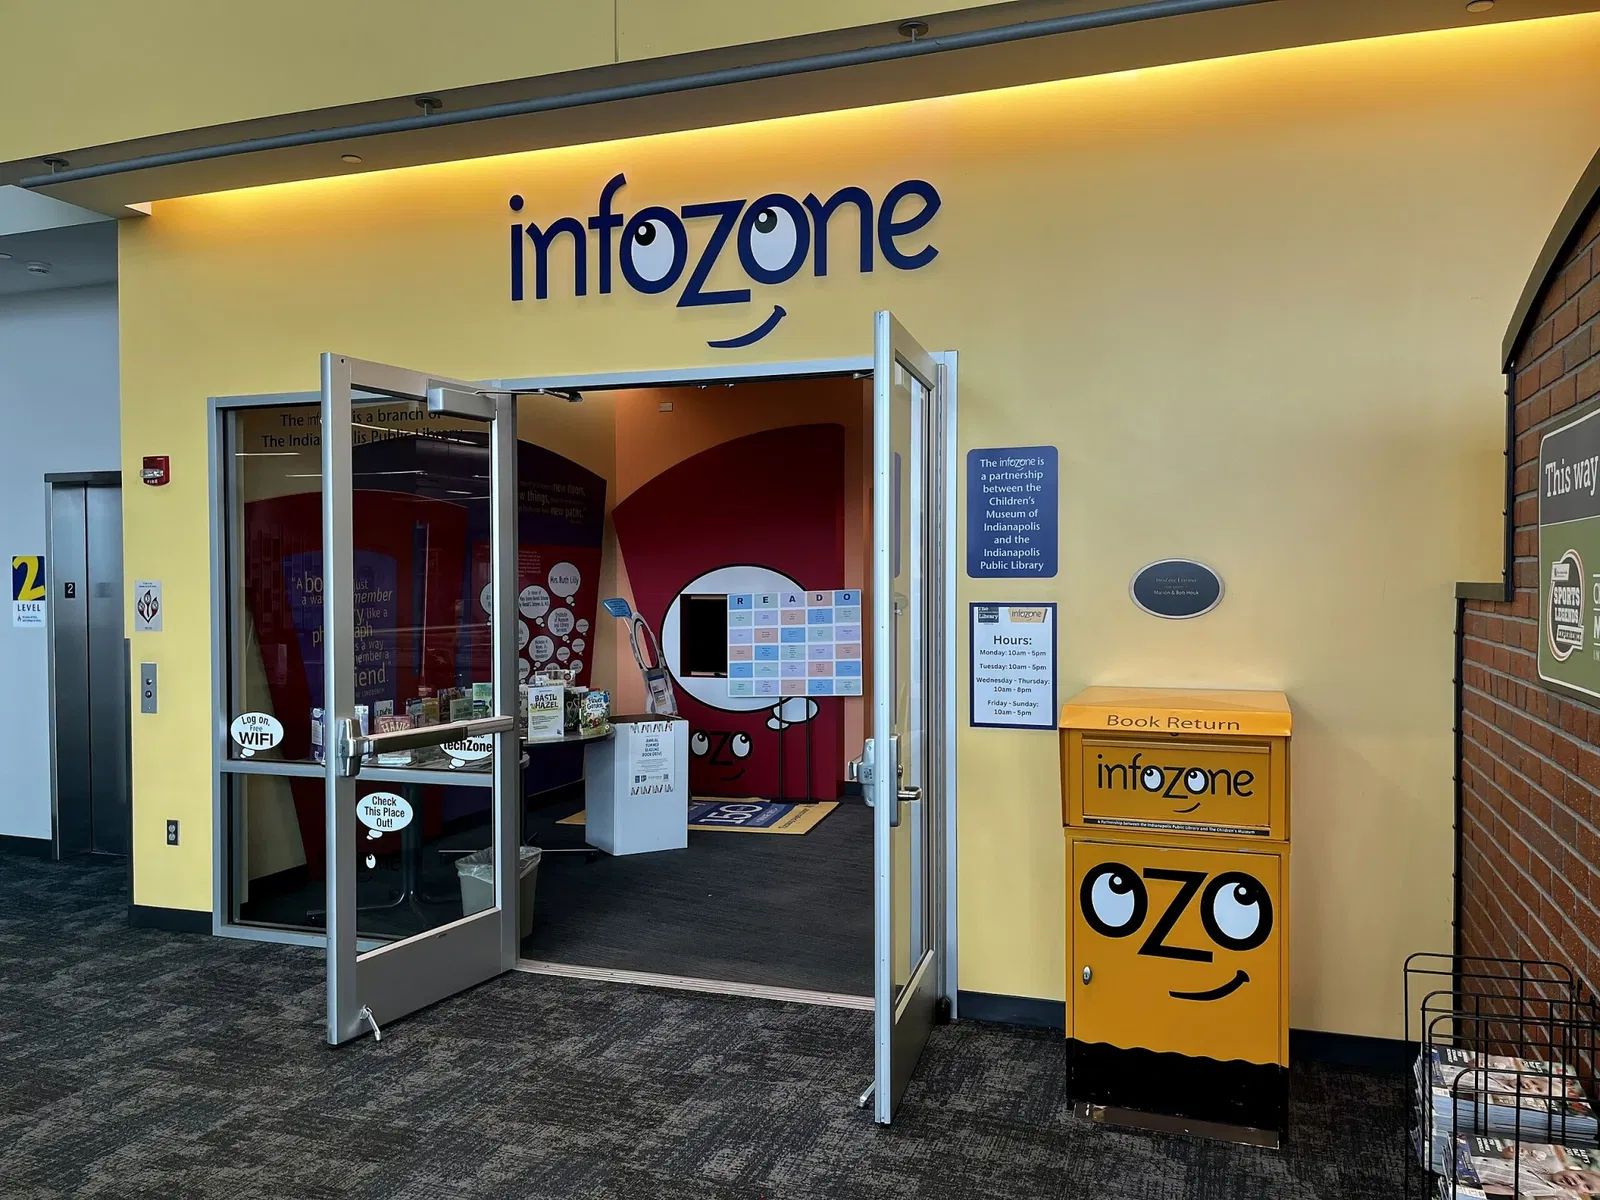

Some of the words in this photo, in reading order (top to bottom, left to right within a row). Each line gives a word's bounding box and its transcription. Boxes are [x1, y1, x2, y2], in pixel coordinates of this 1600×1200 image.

[509, 173, 942, 308] infozone
[280, 414, 304, 427] The
[352, 411, 362, 422] is
[365, 413, 374, 423] a
[378, 409, 424, 421] branch
[262, 434, 285, 447] The
[371, 428, 411, 443] Public
[980, 459, 998, 468] The
[999, 457, 1036, 469] infozone
[1037, 457, 1045, 466] is
[989, 470, 1044, 482] partnership
[1545, 458, 1571, 498] This
[1572, 455, 1599, 497] way
[983, 484, 1023, 493] between
[1026, 483, 1042, 492] the
[989, 496, 1036, 506] Children's
[986, 510, 1026, 519] Museum
[1028, 509, 1039, 518] of
[983, 522, 1041, 533] Indianapolis
[993, 535, 1012, 544] and
[1014, 535, 1030, 544] the
[983, 548, 1041, 559] Indianapolis
[980, 561, 1009, 570] Public
[1011, 561, 1045, 572] Library
[12, 556, 46, 602] 2
[67, 584, 74, 594] 2
[737, 597, 744, 605] R
[762, 596, 769, 604] E
[788, 595, 796, 603] A
[816, 594, 823, 602] D
[843, 593, 851, 601] O
[1553, 586, 1580, 606] SPORTS
[17, 603, 41, 612] LEVEL
[1554, 607, 1579, 624] LEGENDS
[993, 635, 1032, 645] Hours:
[534, 694, 558, 702] BASIL
[535, 701, 559, 709] HAZEL
[1013, 700, 1039, 708] Sunday:
[241, 716, 256, 725] Log
[258, 716, 270, 726] on.
[1107, 714, 1160, 728] Book
[1167, 716, 1240, 731] Return
[239, 731, 273, 746] WIFI
[1097, 753, 1255, 800] infozone
[371, 795, 397, 807] Check
[364, 806, 381, 817] This
[383, 807, 405, 818] Place
[376, 817, 393, 828] Out!
